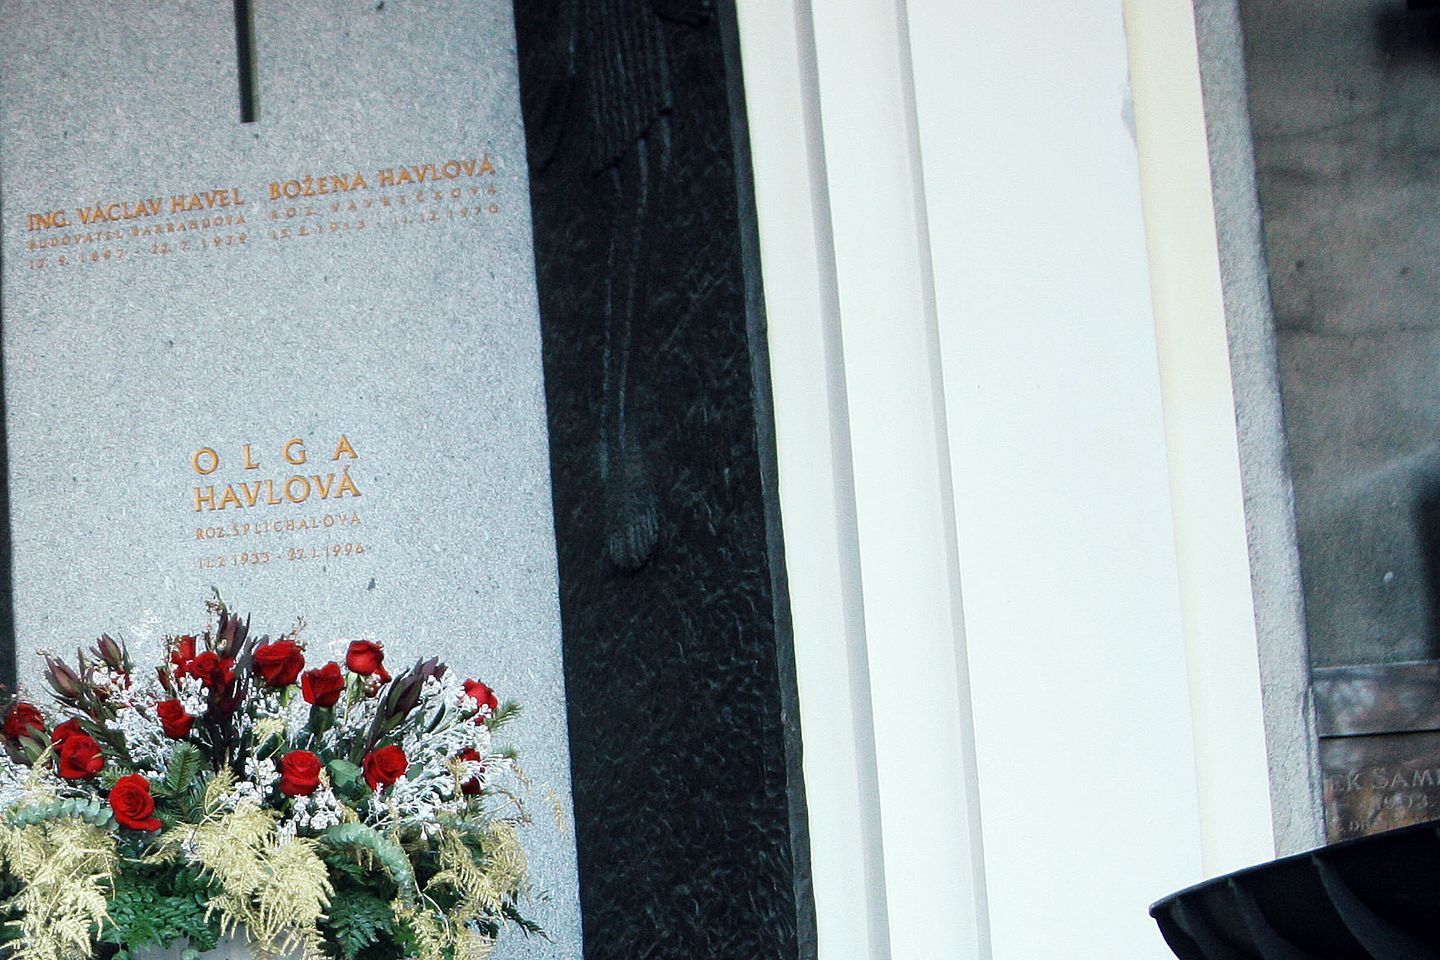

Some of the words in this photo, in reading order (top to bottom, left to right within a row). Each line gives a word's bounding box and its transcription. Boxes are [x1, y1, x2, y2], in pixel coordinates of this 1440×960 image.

[268, 171, 368, 201] BOŽENA
[377, 151, 496, 188] HAVLOVÁ
[27, 209, 71, 232] ING.
[170, 187, 245, 214] HAVEL
[191, 434, 358, 475] OLGA
[193, 465, 362, 512] HAVLOVÁ
